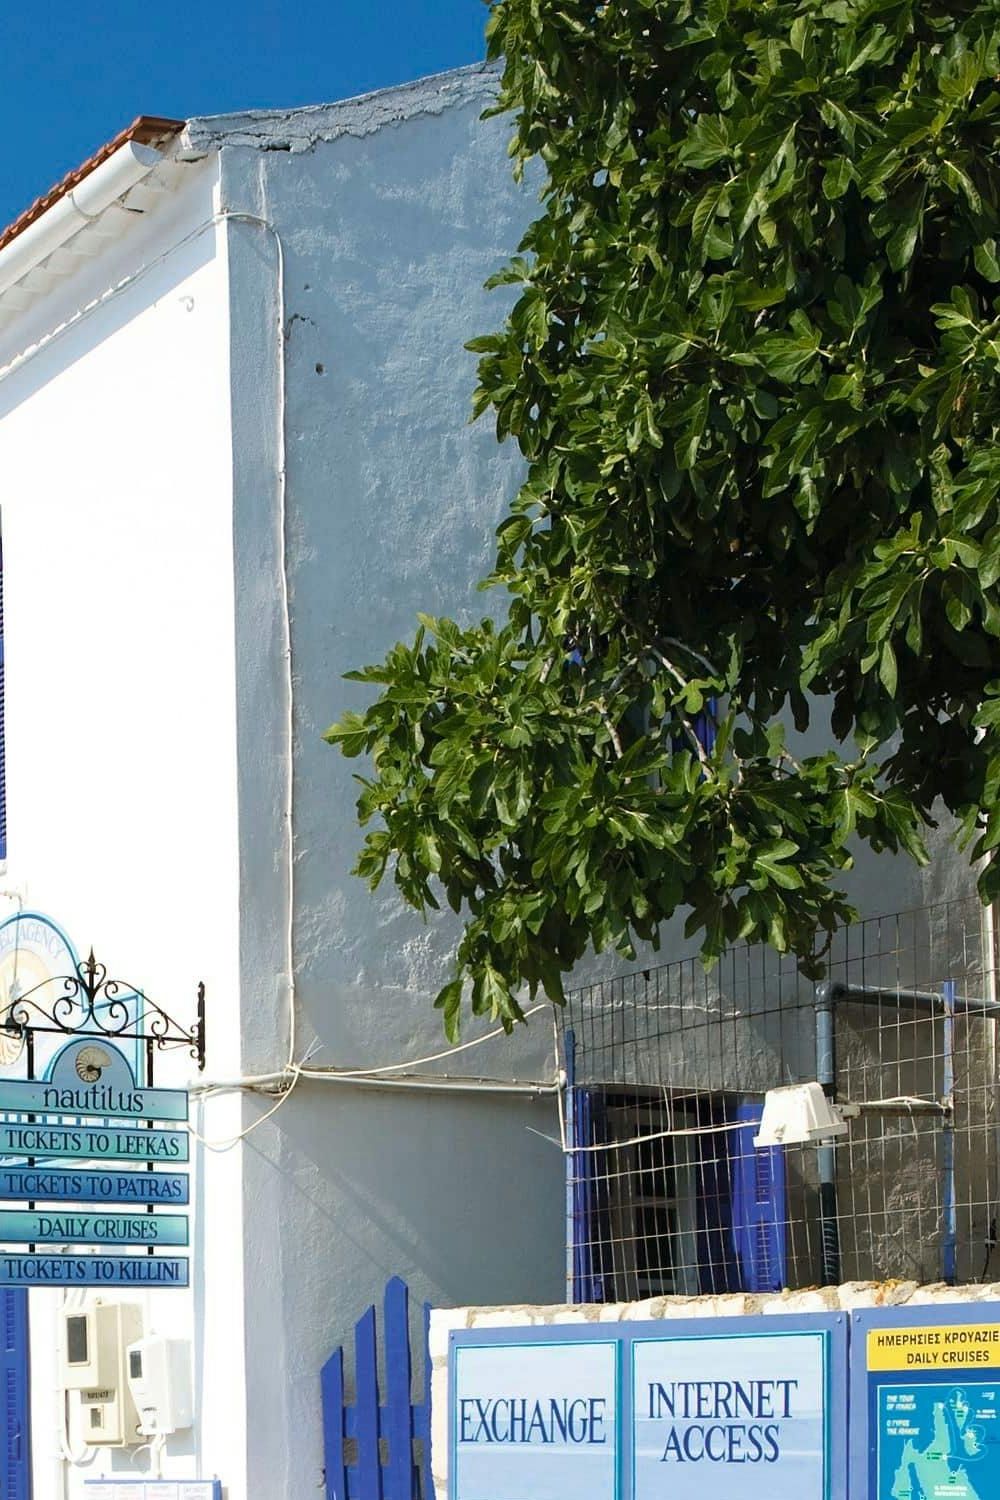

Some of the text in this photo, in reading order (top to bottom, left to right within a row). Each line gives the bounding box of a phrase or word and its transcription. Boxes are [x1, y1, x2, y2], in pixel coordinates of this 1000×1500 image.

[43, 1084, 144, 1112] nautilus
[5, 1129, 180, 1156] TICKETS TO LEFKAS
[4, 1174, 182, 1197] TICKETS TO PATRAS
[38, 1218, 158, 1239] DAILY CRUISES
[4, 1259, 180, 1280] TICKETS TO KILLINI
[877, 1333, 941, 1346] ΗΜΕΡΗΣΙΕΣ
[906, 1350, 990, 1364] DAILY CRUISES
[648, 1380, 798, 1419] INTERNET
[459, 1398, 607, 1444] EXCHANGE
[660, 1424, 780, 1463] ACCESS
